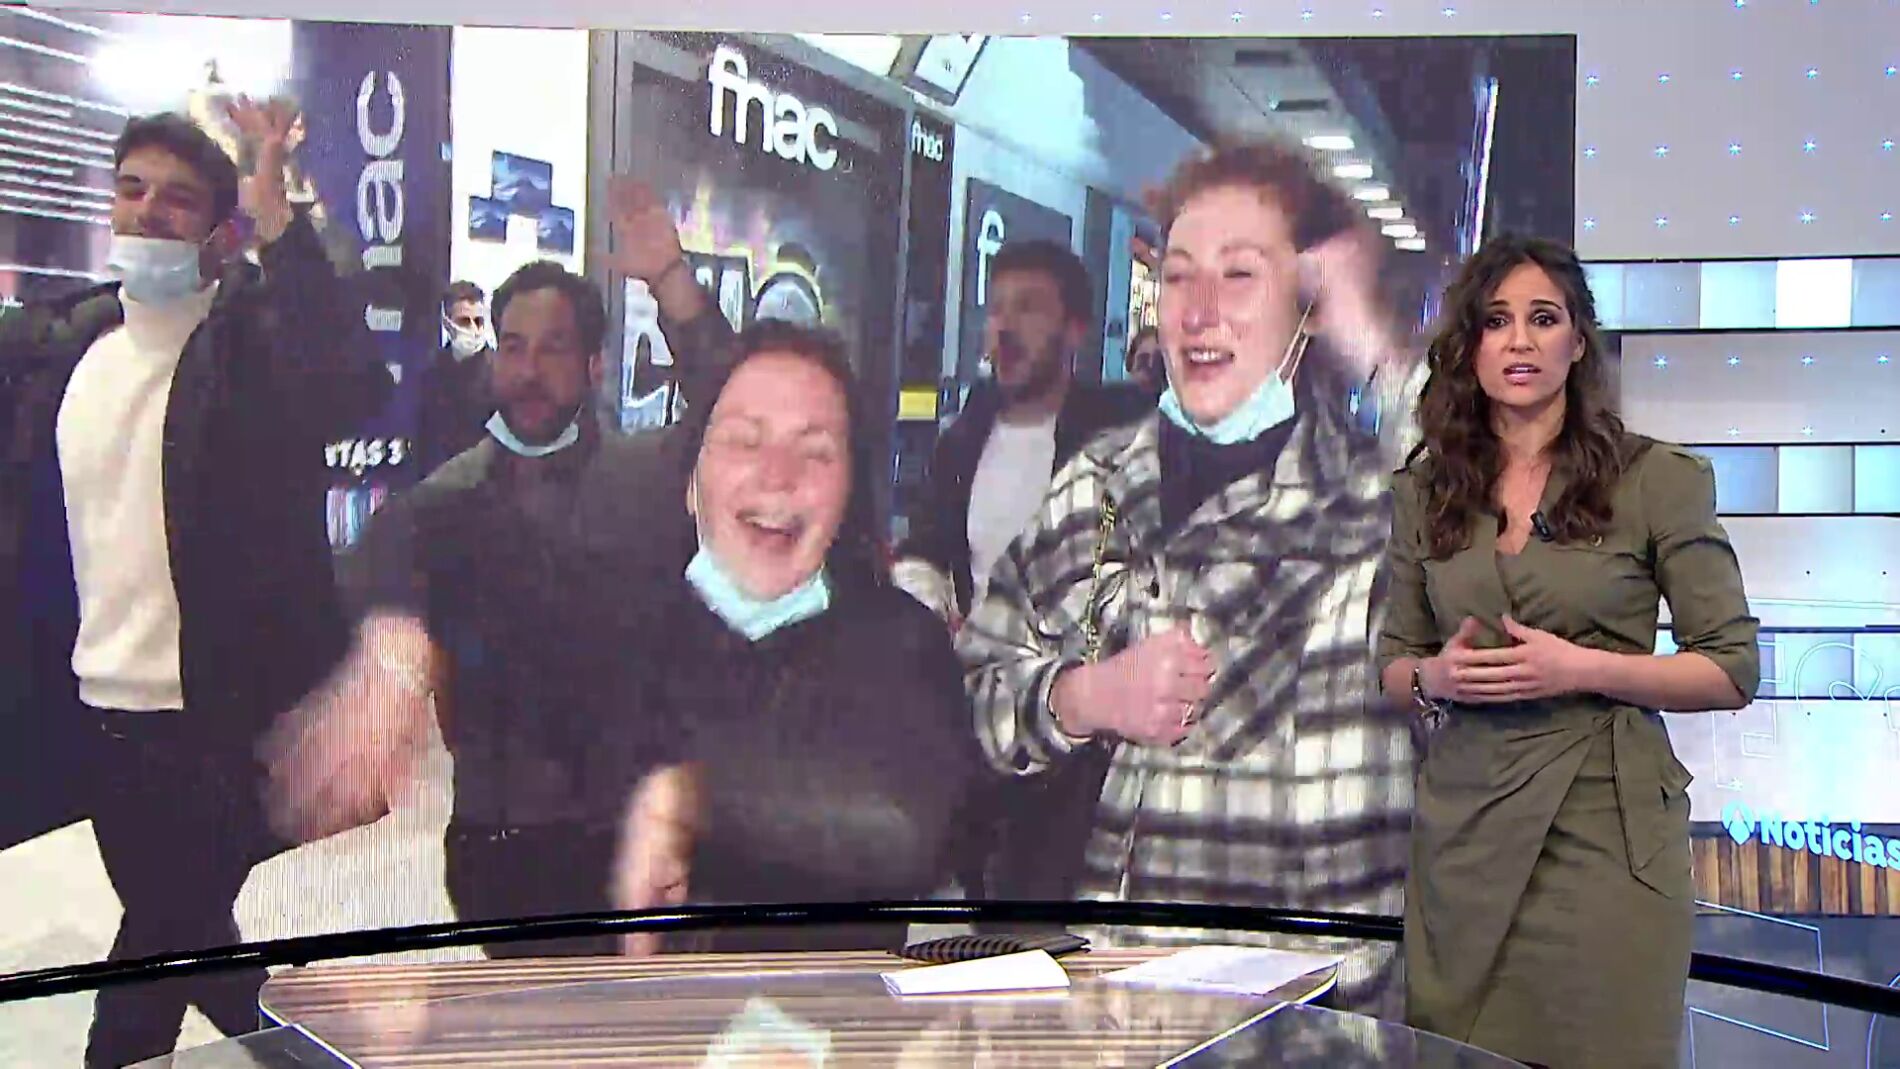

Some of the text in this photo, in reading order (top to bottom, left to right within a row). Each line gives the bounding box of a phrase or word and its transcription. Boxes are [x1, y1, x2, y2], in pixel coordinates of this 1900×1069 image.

[707, 44, 838, 170] fnac
[356, 70, 405, 385] nac
[1758, 810, 1900, 871] Noticias
